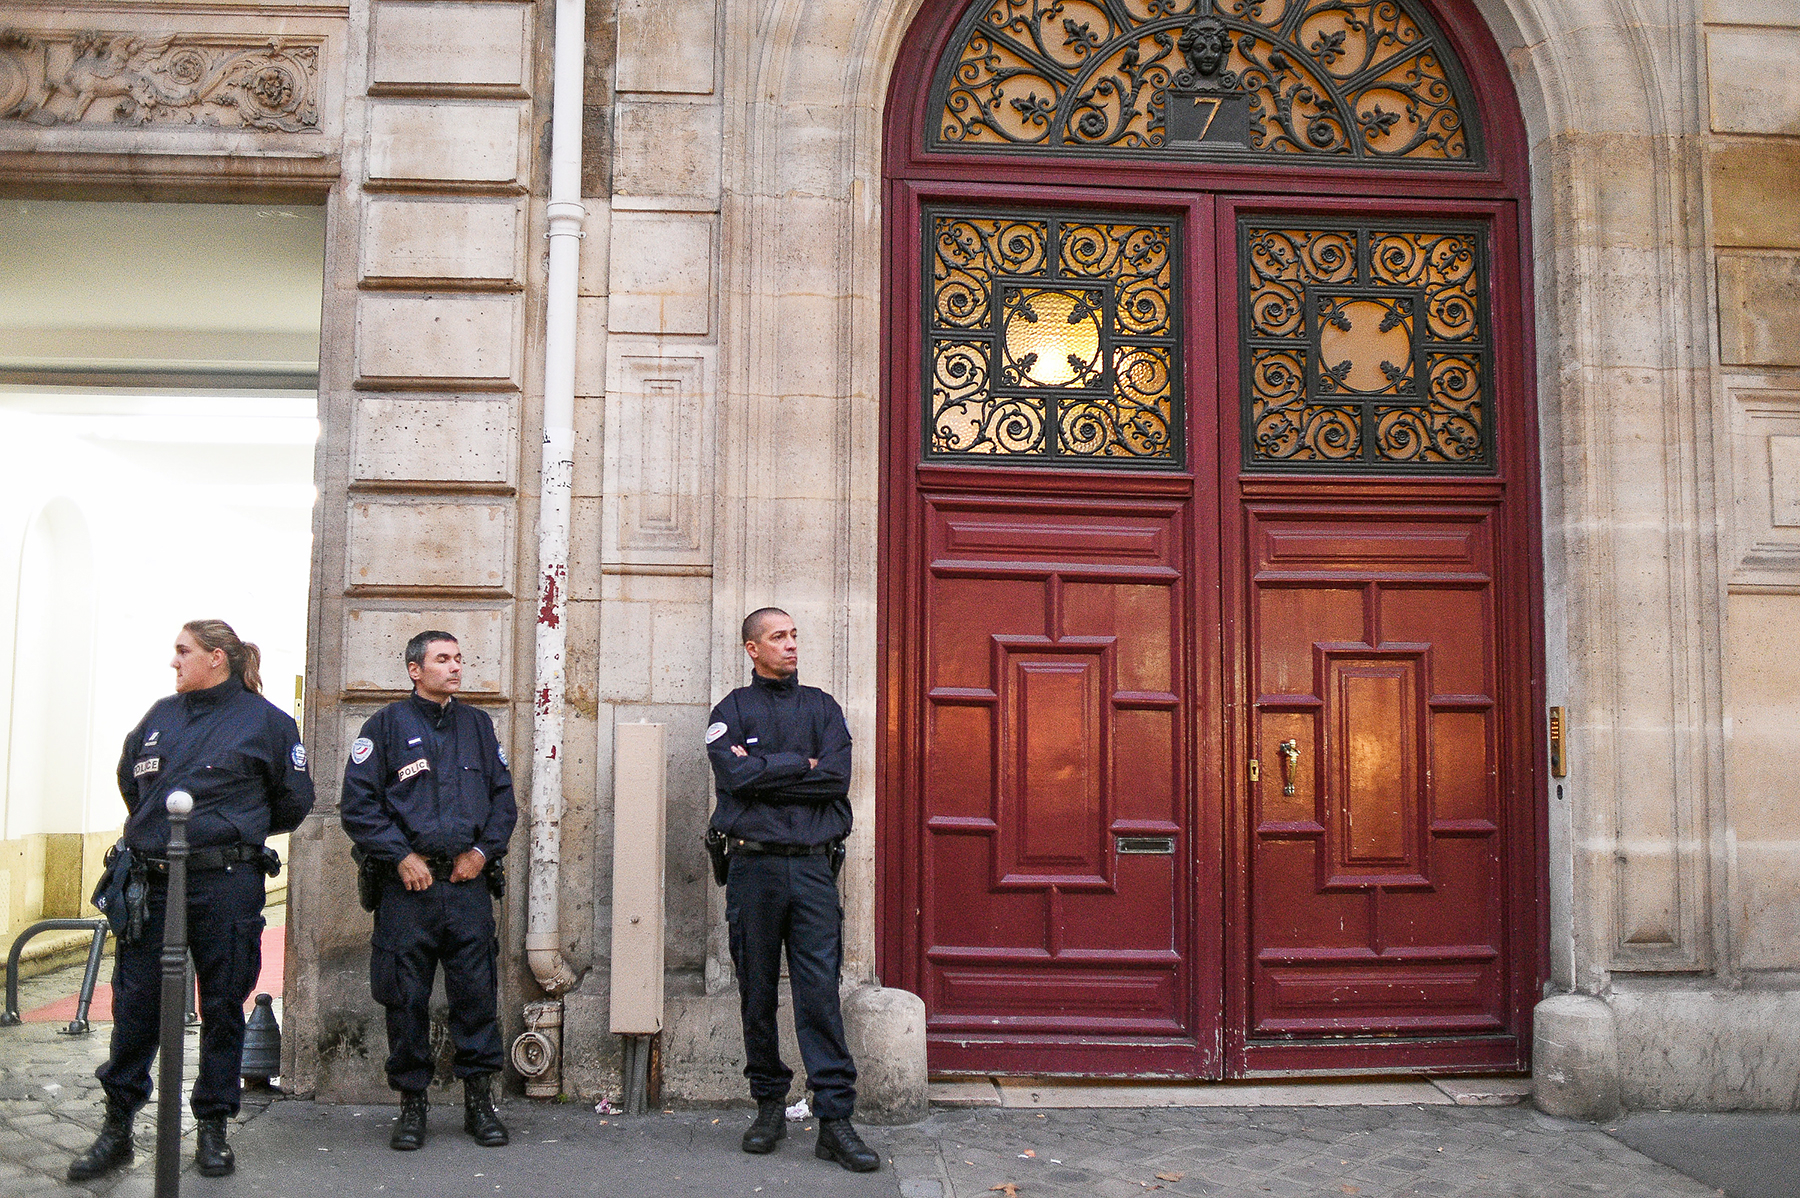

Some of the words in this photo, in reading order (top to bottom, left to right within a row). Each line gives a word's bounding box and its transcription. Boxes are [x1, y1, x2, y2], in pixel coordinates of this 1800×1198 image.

[1194, 97, 1223, 141] 7
[134, 760, 158, 775] OLICE
[399, 761, 429, 780] POLIC
